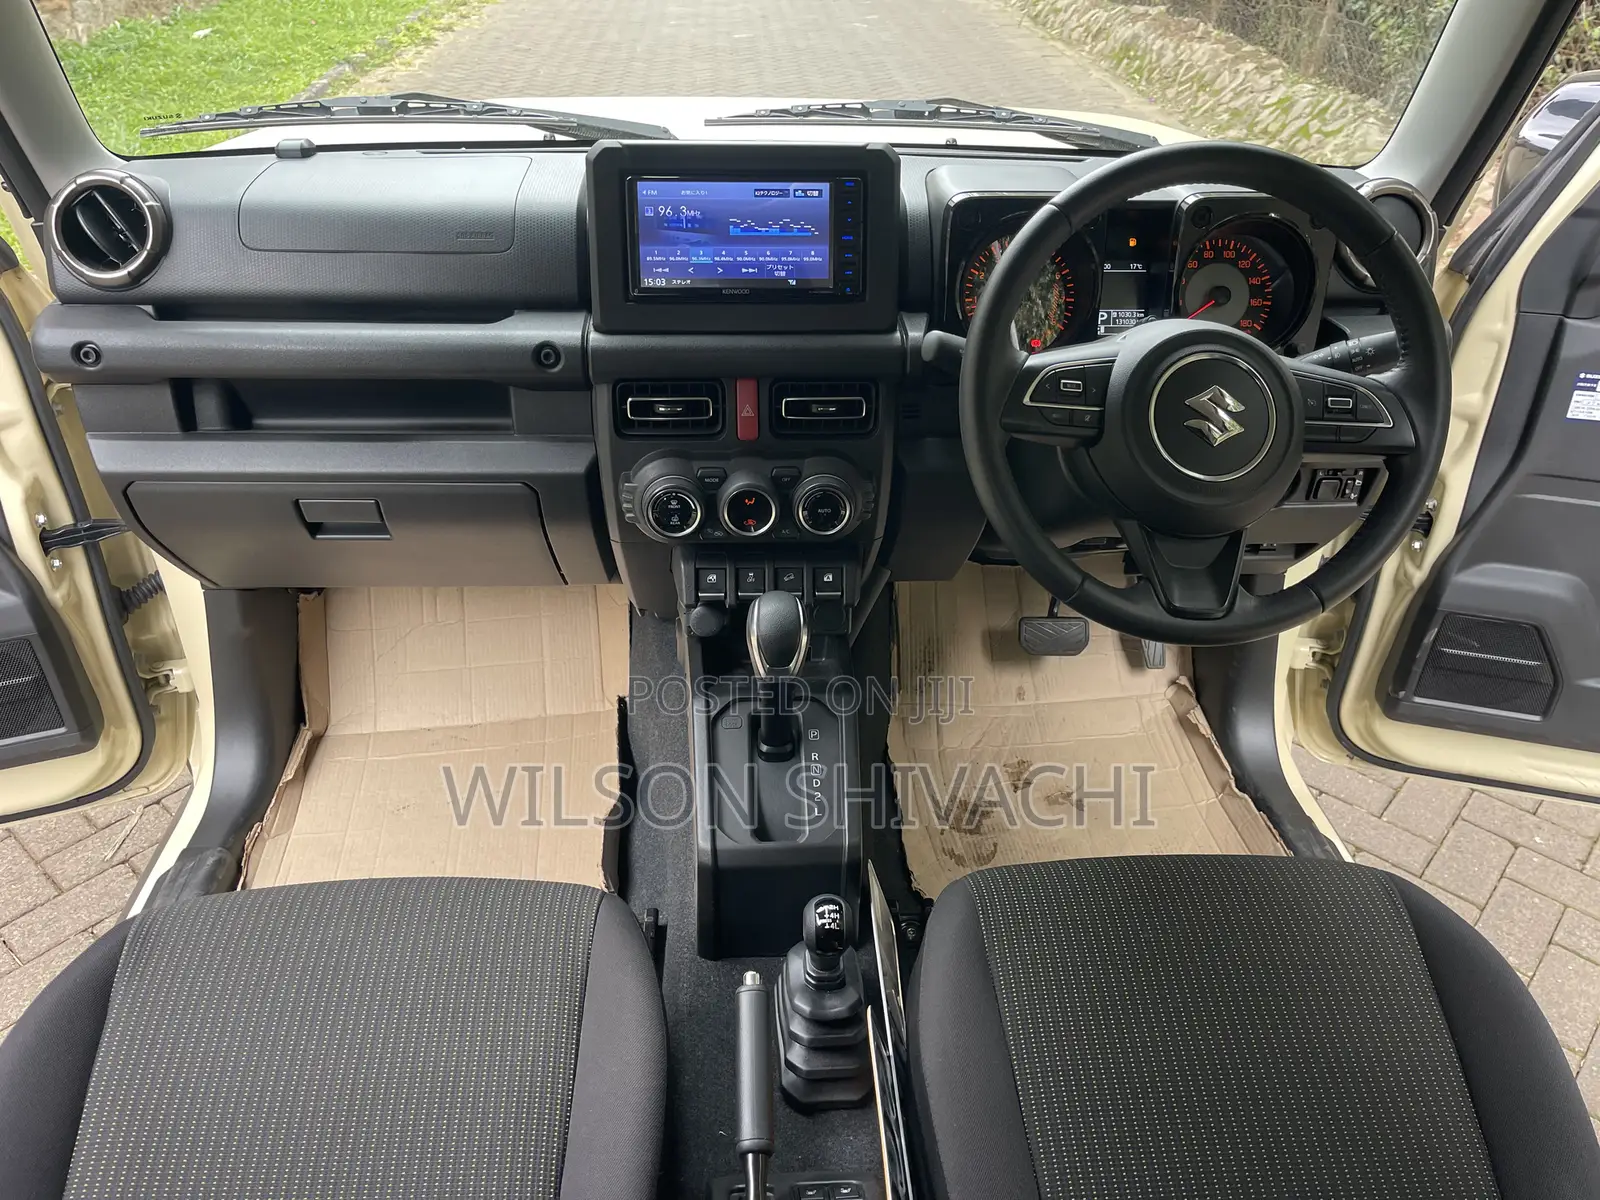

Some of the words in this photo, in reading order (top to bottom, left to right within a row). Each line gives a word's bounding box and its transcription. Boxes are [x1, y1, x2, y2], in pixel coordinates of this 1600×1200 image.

[1203, 250, 1215, 259] 80
[1223, 250, 1236, 259] 100
[1187, 260, 1198, 269] 60
[1238, 260, 1251, 269] 120
[643, 278, 666, 286] 15:03
[1248, 277, 1261, 285] 140
[1250, 298, 1263, 307] 160
[1098, 311, 1108, 325] P
[1240, 319, 1253, 328] 180
[810, 730, 818, 739] P
[811, 752, 819, 761] R
[813, 779, 821, 788] D
[814, 792, 822, 802] 2
[814, 807, 822, 816] L
[829, 912, 840, 920] 4H
